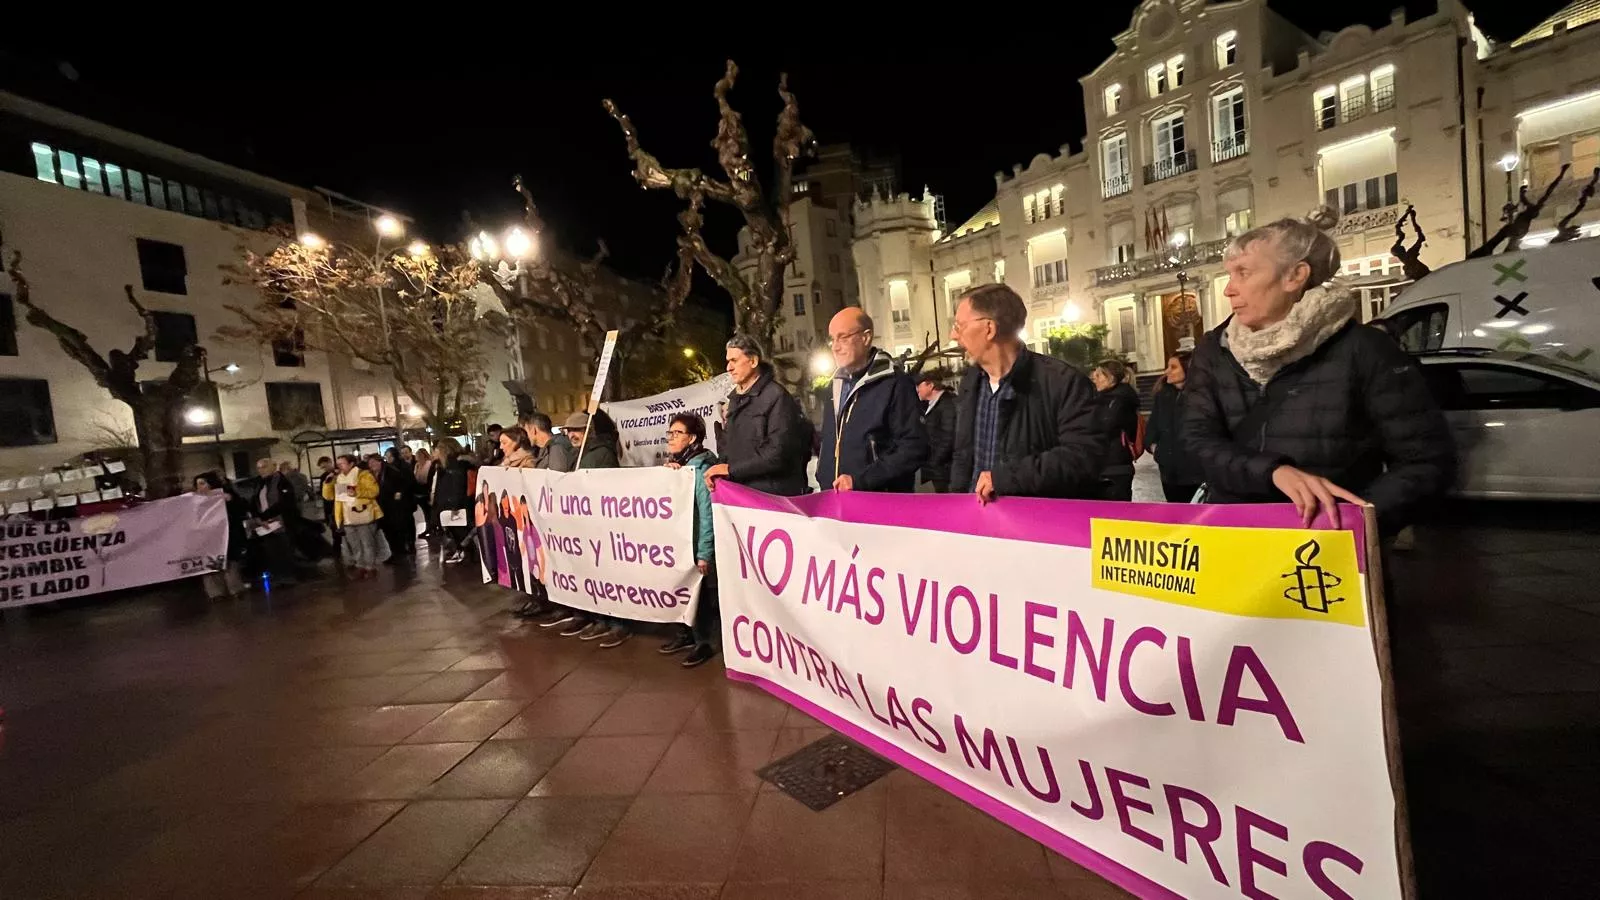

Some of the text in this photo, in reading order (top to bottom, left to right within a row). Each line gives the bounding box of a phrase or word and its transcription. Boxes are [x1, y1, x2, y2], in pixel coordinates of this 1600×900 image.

[645, 399, 686, 413] BASTA DE
[620, 414, 667, 428] VIOLENCIAS
[560, 494, 592, 516] una
[601, 494, 673, 520] menos
[44, 520, 71, 535] LA
[544, 528, 676, 568] vivas y libres
[1101, 536, 1200, 572] AMNISTÍA
[0, 556, 86, 580] CAMBIE
[1101, 565, 1196, 595] INTERNACIONAL
[30, 575, 90, 597] LADO
[552, 569, 691, 609] nos queremos
[732, 523, 1306, 745] NO MÁS VIOLENCIA
[733, 615, 862, 710] CONTRA
[857, 673, 947, 754] LAS
